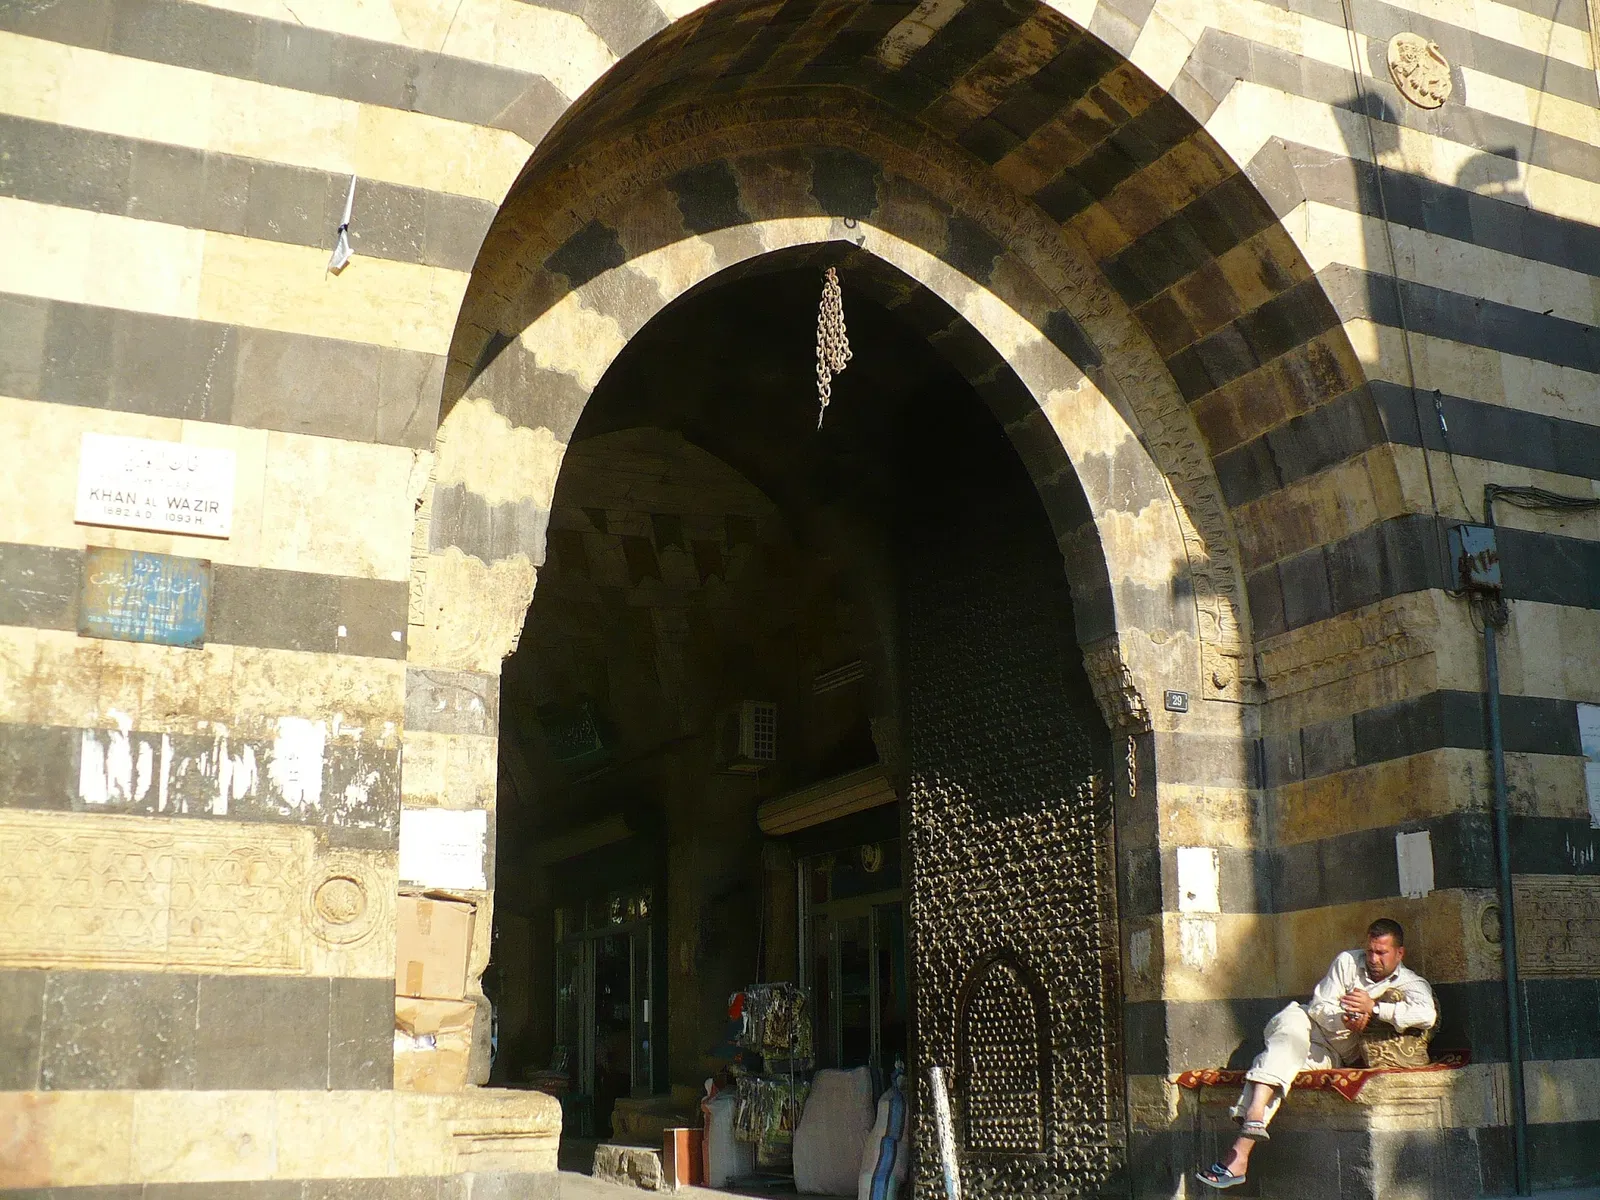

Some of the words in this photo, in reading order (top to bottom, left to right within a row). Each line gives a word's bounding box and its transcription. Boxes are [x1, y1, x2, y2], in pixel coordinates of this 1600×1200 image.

[89, 488, 137, 505] KHAN
[144, 497, 157, 508] AL
[166, 496, 220, 514] WAZIR
[165, 513, 191, 524] 1093
[1172, 695, 1182, 706] 29
